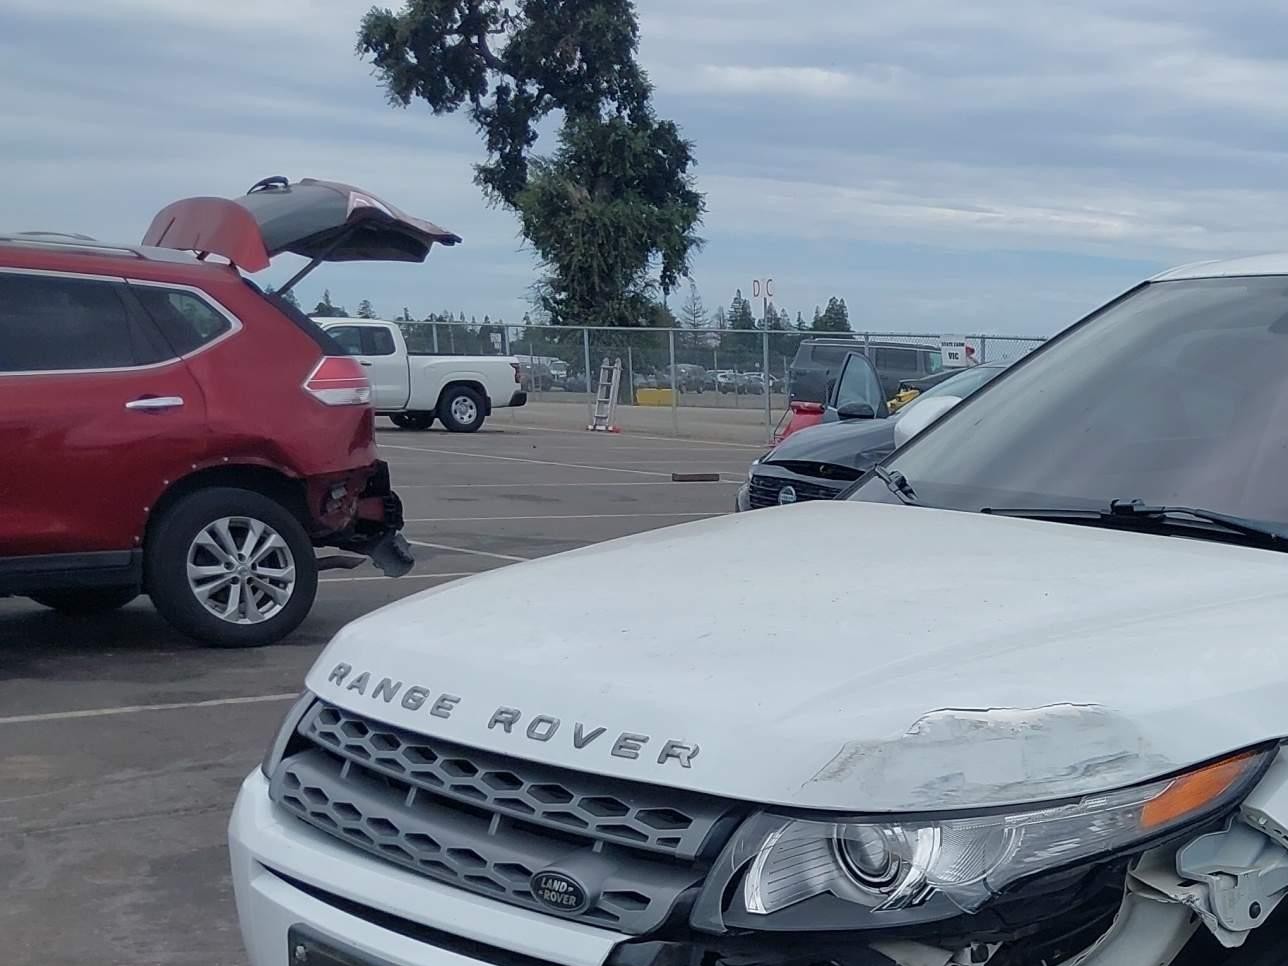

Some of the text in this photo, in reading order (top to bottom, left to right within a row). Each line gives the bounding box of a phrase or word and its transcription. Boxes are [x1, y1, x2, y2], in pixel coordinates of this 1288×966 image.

[752, 278, 774, 298] D C
[327, 661, 700, 769] RANGE ROVER
[541, 876, 568, 894] LAND
[543, 889, 577, 907] ROVER
